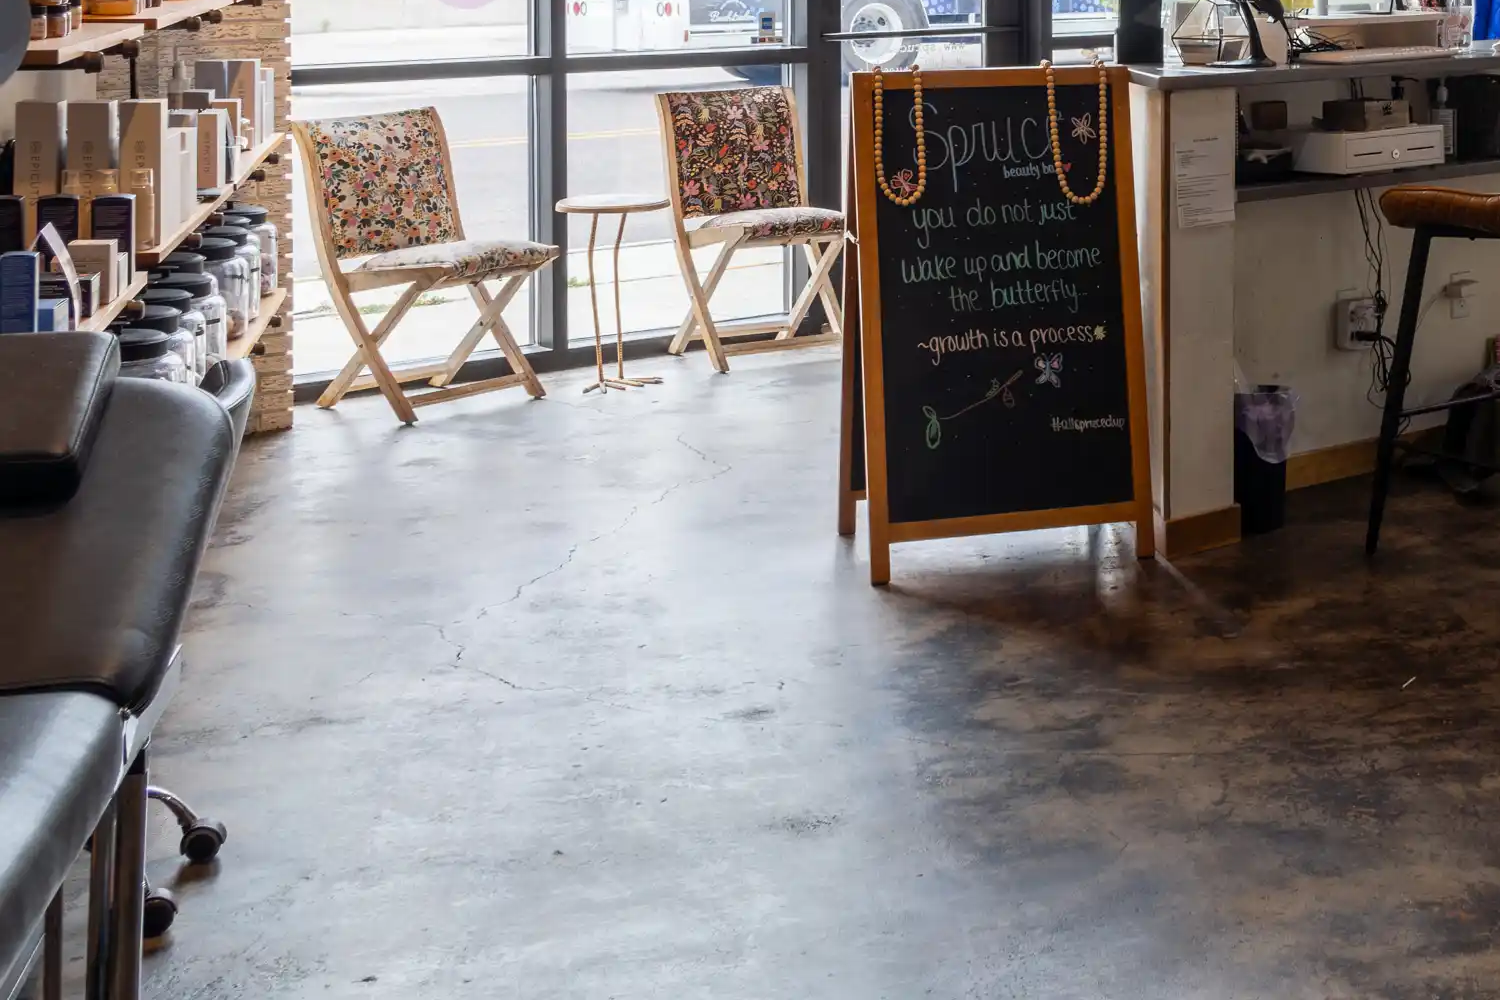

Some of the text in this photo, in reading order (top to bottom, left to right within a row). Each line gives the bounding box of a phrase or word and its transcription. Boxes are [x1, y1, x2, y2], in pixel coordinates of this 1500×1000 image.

[80, 155, 93, 207] EPICUT
[1003, 162, 1042, 180] beauty
[912, 197, 1077, 249] you do not just
[964, 256, 988, 282] up
[991, 244, 1033, 272] and
[1035, 239, 1101, 270] become
[948, 285, 983, 312] the
[993, 328, 1009, 347] is
[1011, 332, 1027, 348] a
[1029, 324, 1095, 354] process
